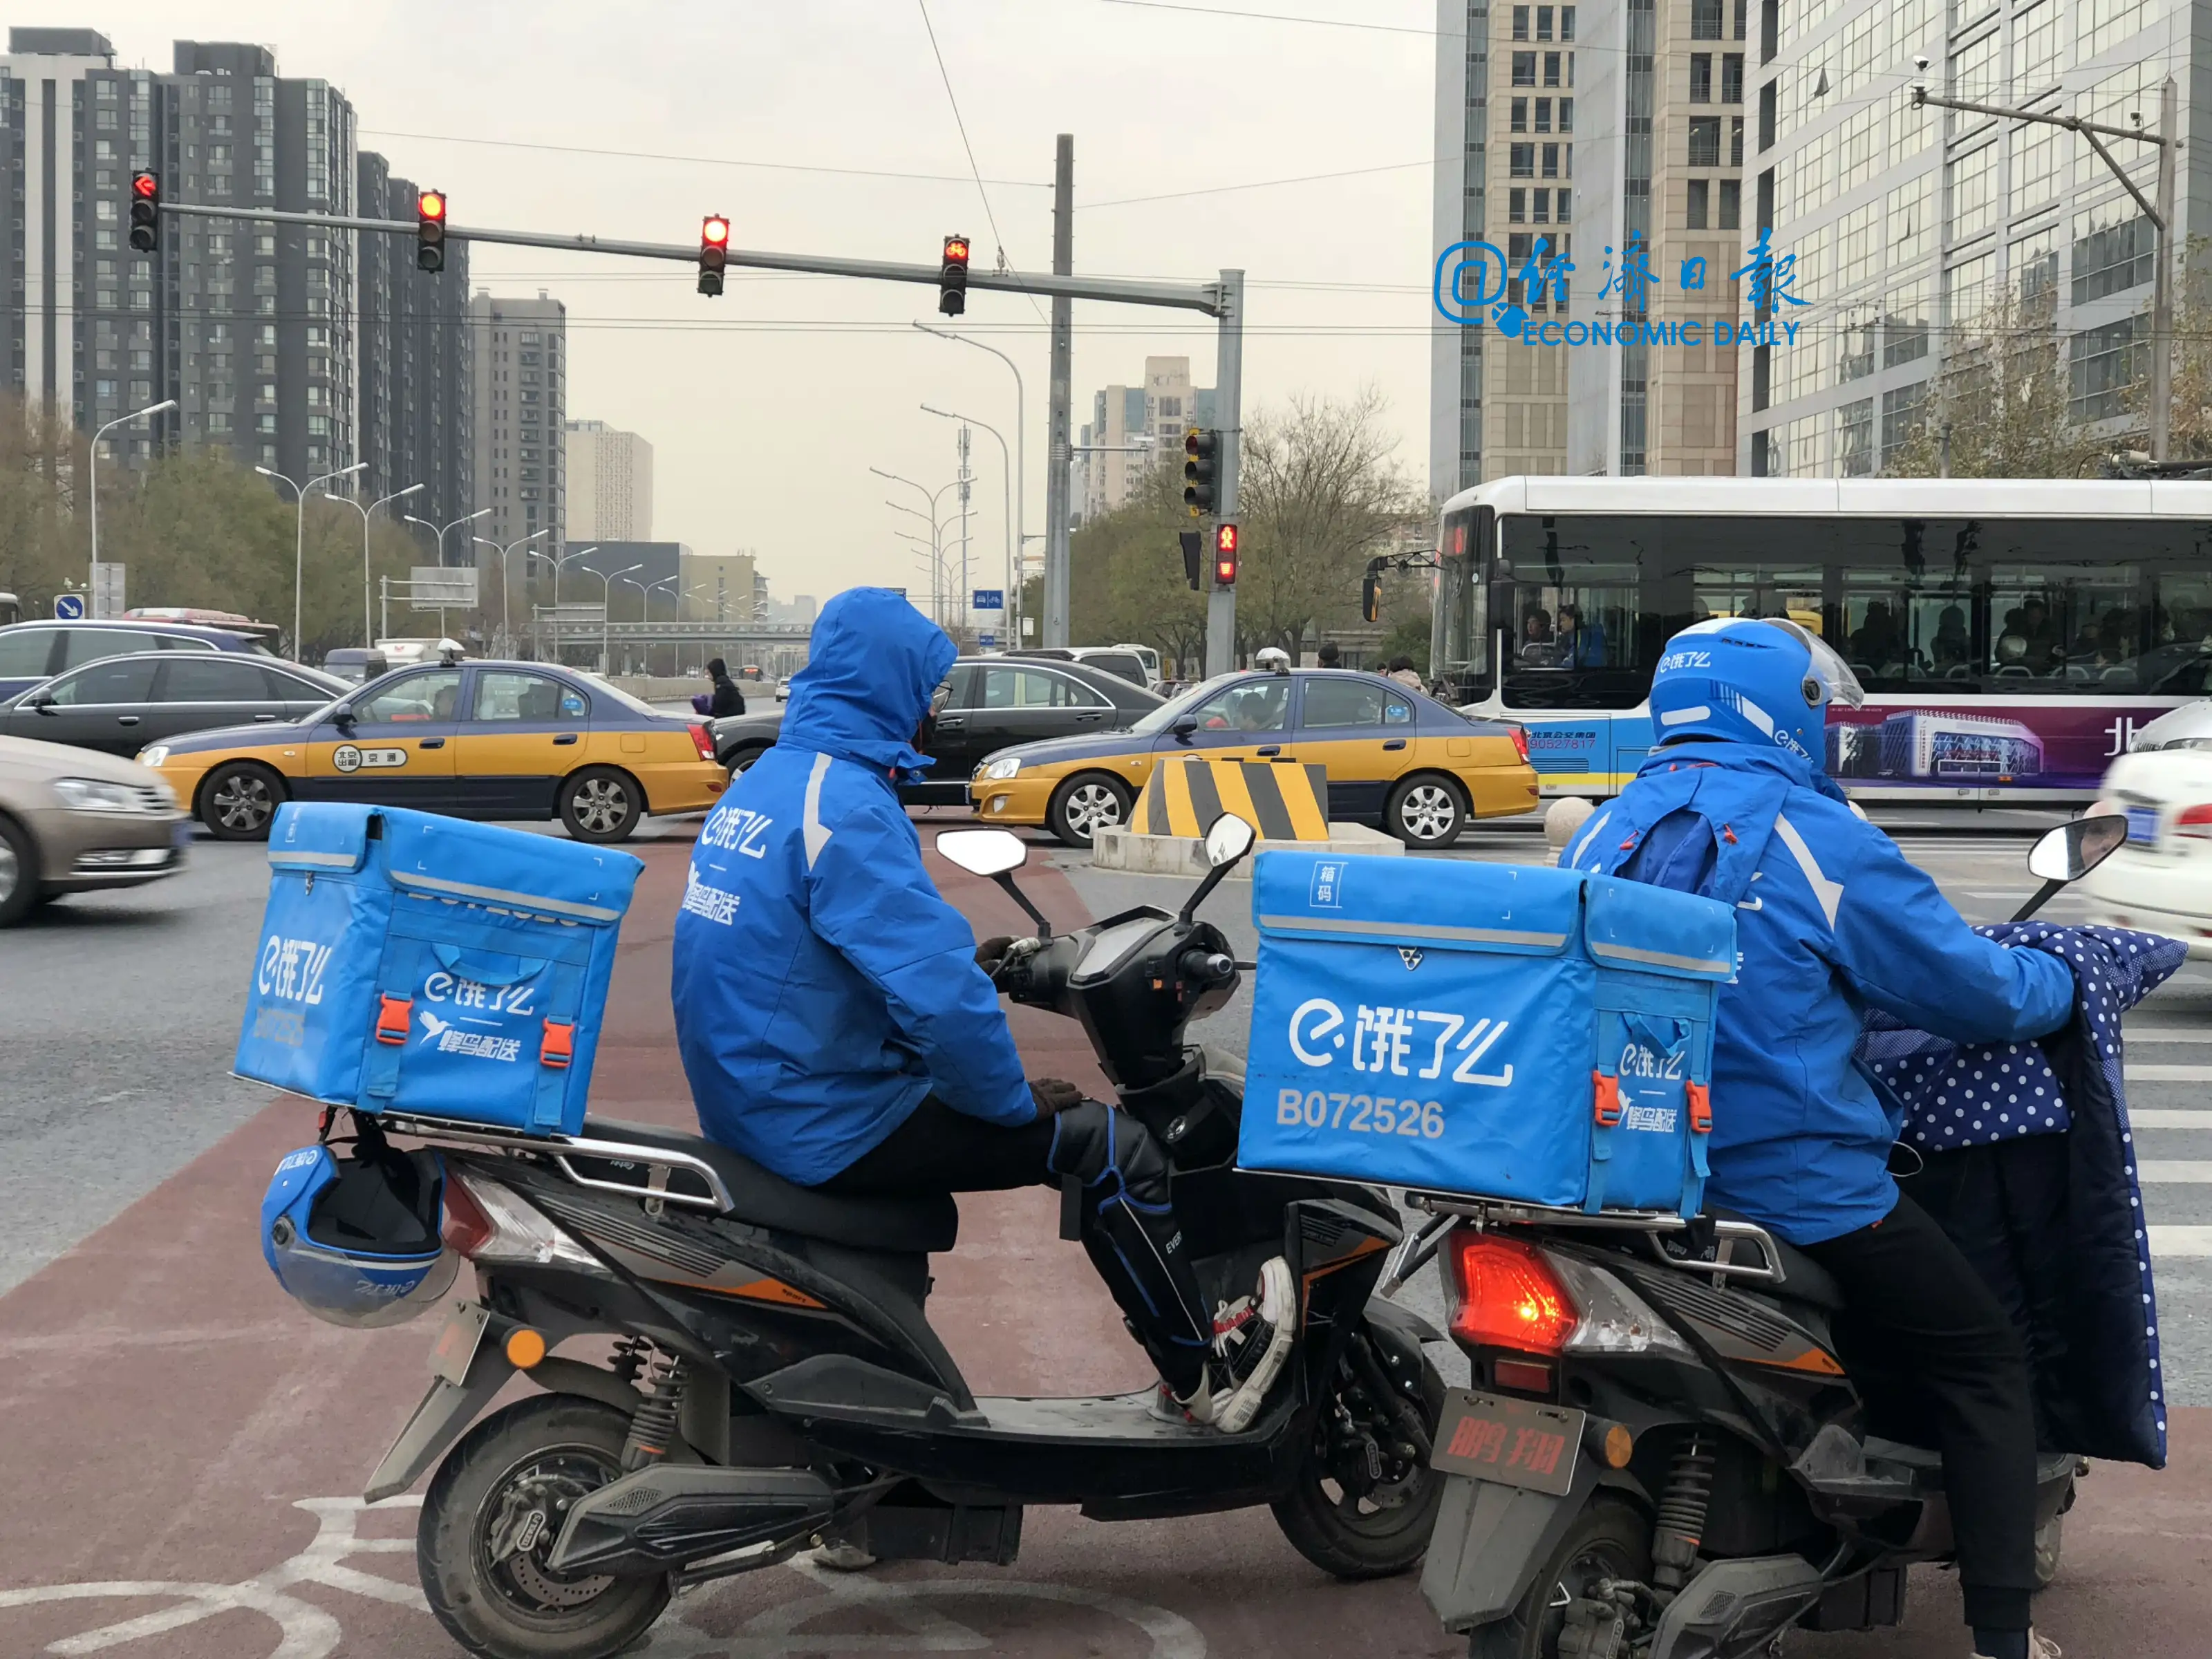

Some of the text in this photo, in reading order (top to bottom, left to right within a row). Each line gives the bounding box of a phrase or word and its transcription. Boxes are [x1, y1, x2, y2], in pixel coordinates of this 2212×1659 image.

[1530, 739, 1595, 749] 90527817
[437, 1030, 521, 1062] 蜂鸟配送
[1277, 1088, 1445, 1139] B072526
[1627, 1106, 1678, 1133] 蜂鸟配送
